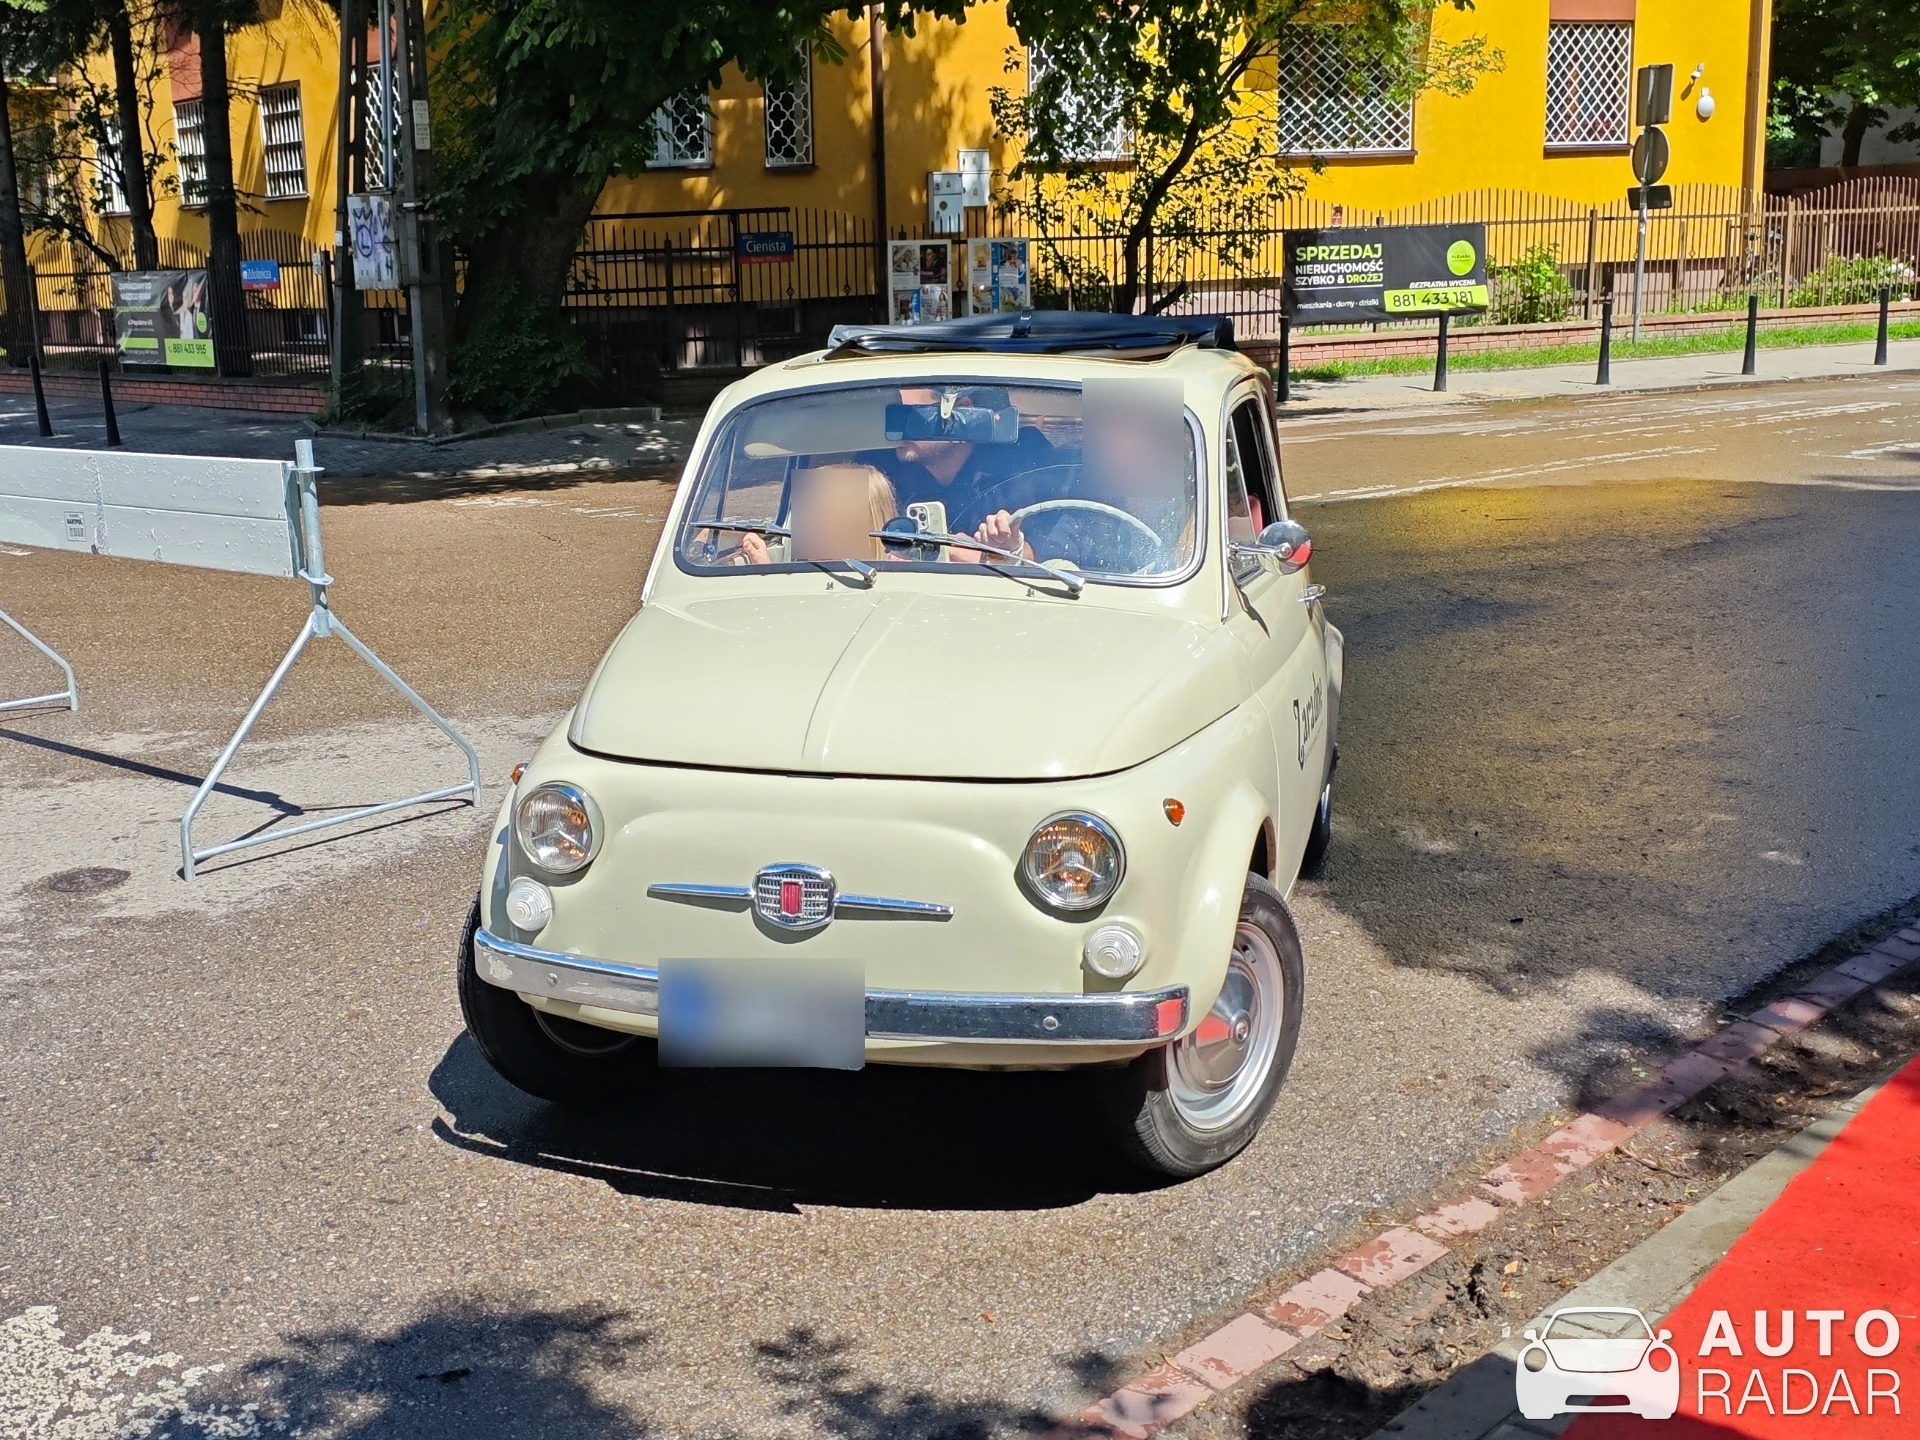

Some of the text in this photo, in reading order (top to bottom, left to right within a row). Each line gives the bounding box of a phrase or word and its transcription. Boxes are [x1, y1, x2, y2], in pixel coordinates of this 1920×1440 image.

[745, 240, 787, 253] Cienista
[1295, 243, 1383, 261] SPRZEDAJ
[1295, 259, 1384, 275] NIERUCHOMOŚĆ
[1295, 271, 1384, 286] SZYBKO & DROŻEJ
[1409, 278, 1477, 289] BEZPŁATNA WYCENA
[1296, 298, 1379, 310] mieszkania domy działki
[1392, 290, 1474, 307] 881 433 181
[184, 343, 195, 354] 433
